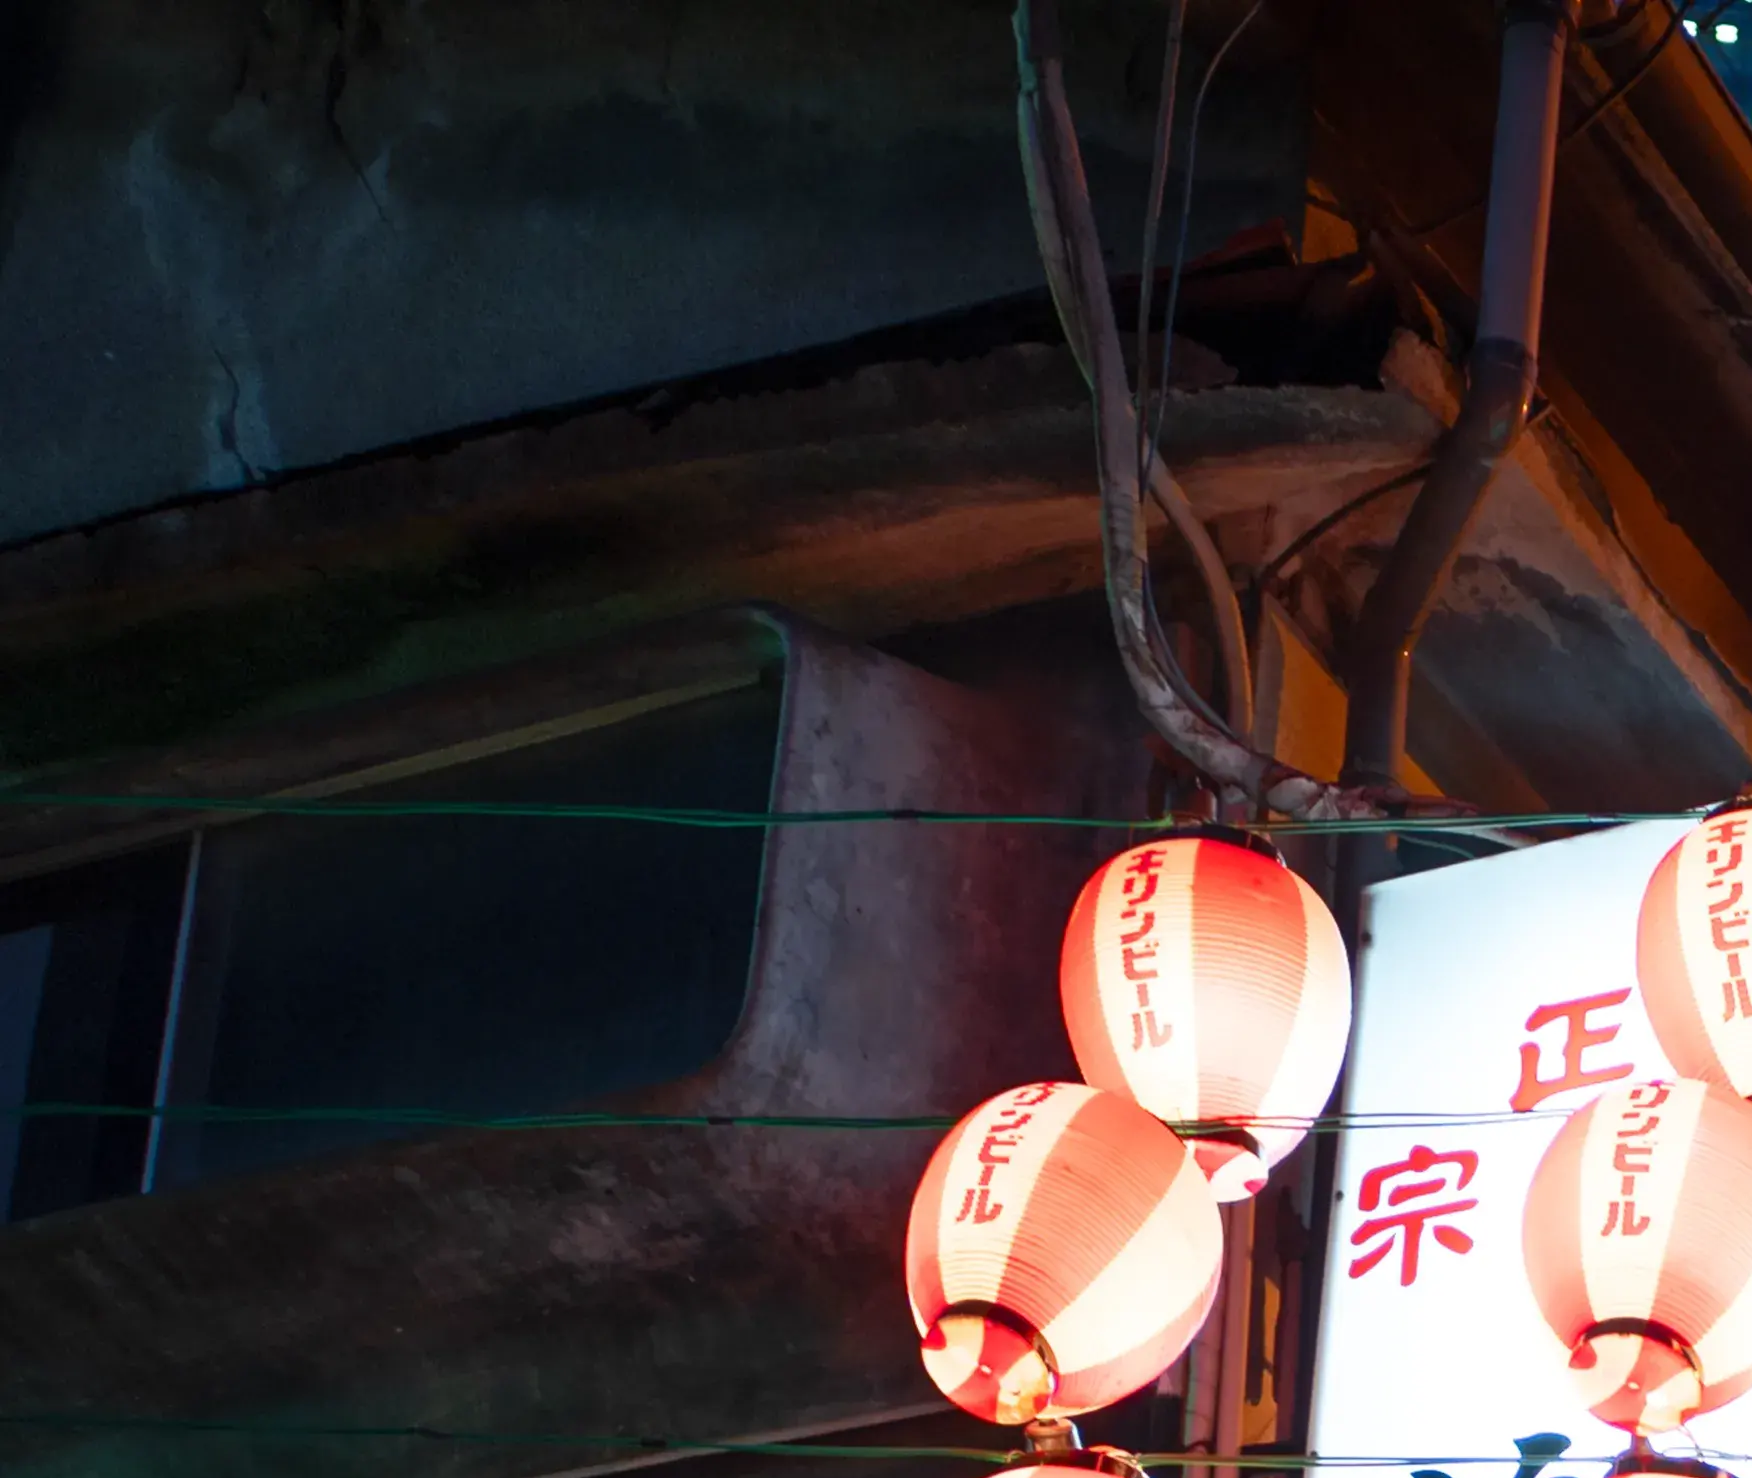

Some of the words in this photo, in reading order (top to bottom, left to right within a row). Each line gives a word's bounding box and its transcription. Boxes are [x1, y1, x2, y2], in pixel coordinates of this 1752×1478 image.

[1120, 848, 1174, 1052] キリンビール
[1600, 1078, 1677, 1238] リンビール
